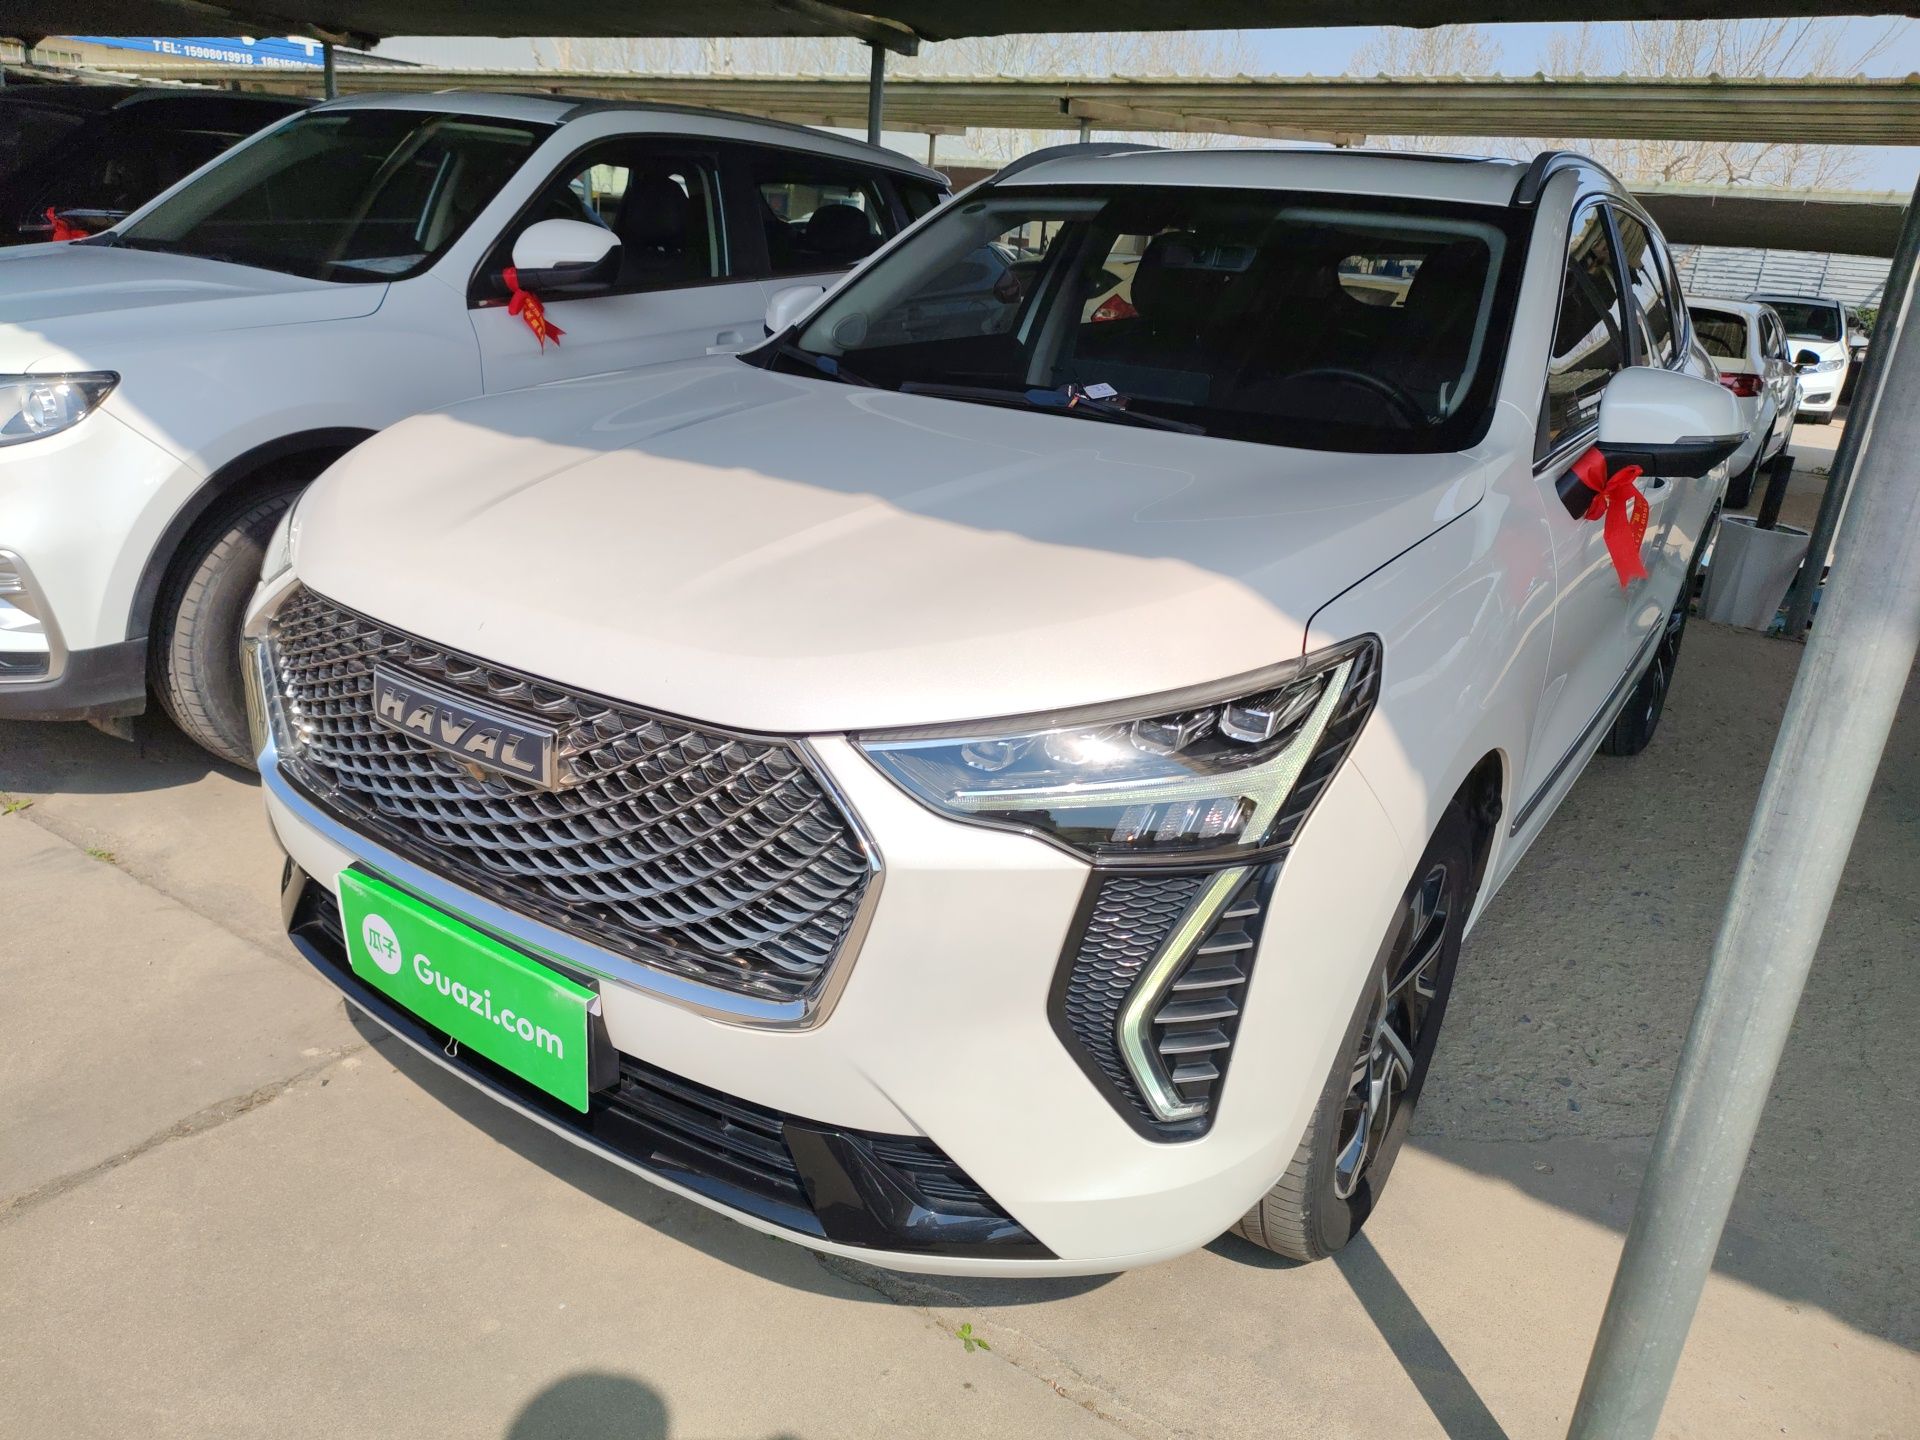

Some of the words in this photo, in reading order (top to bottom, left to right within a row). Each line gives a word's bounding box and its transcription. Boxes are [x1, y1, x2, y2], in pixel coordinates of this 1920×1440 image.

[153, 39, 181, 54] TEL:
[381, 688, 535, 772] HAVAL
[369, 928, 396, 958] 瓜子
[414, 954, 563, 1059] Guazi.com
